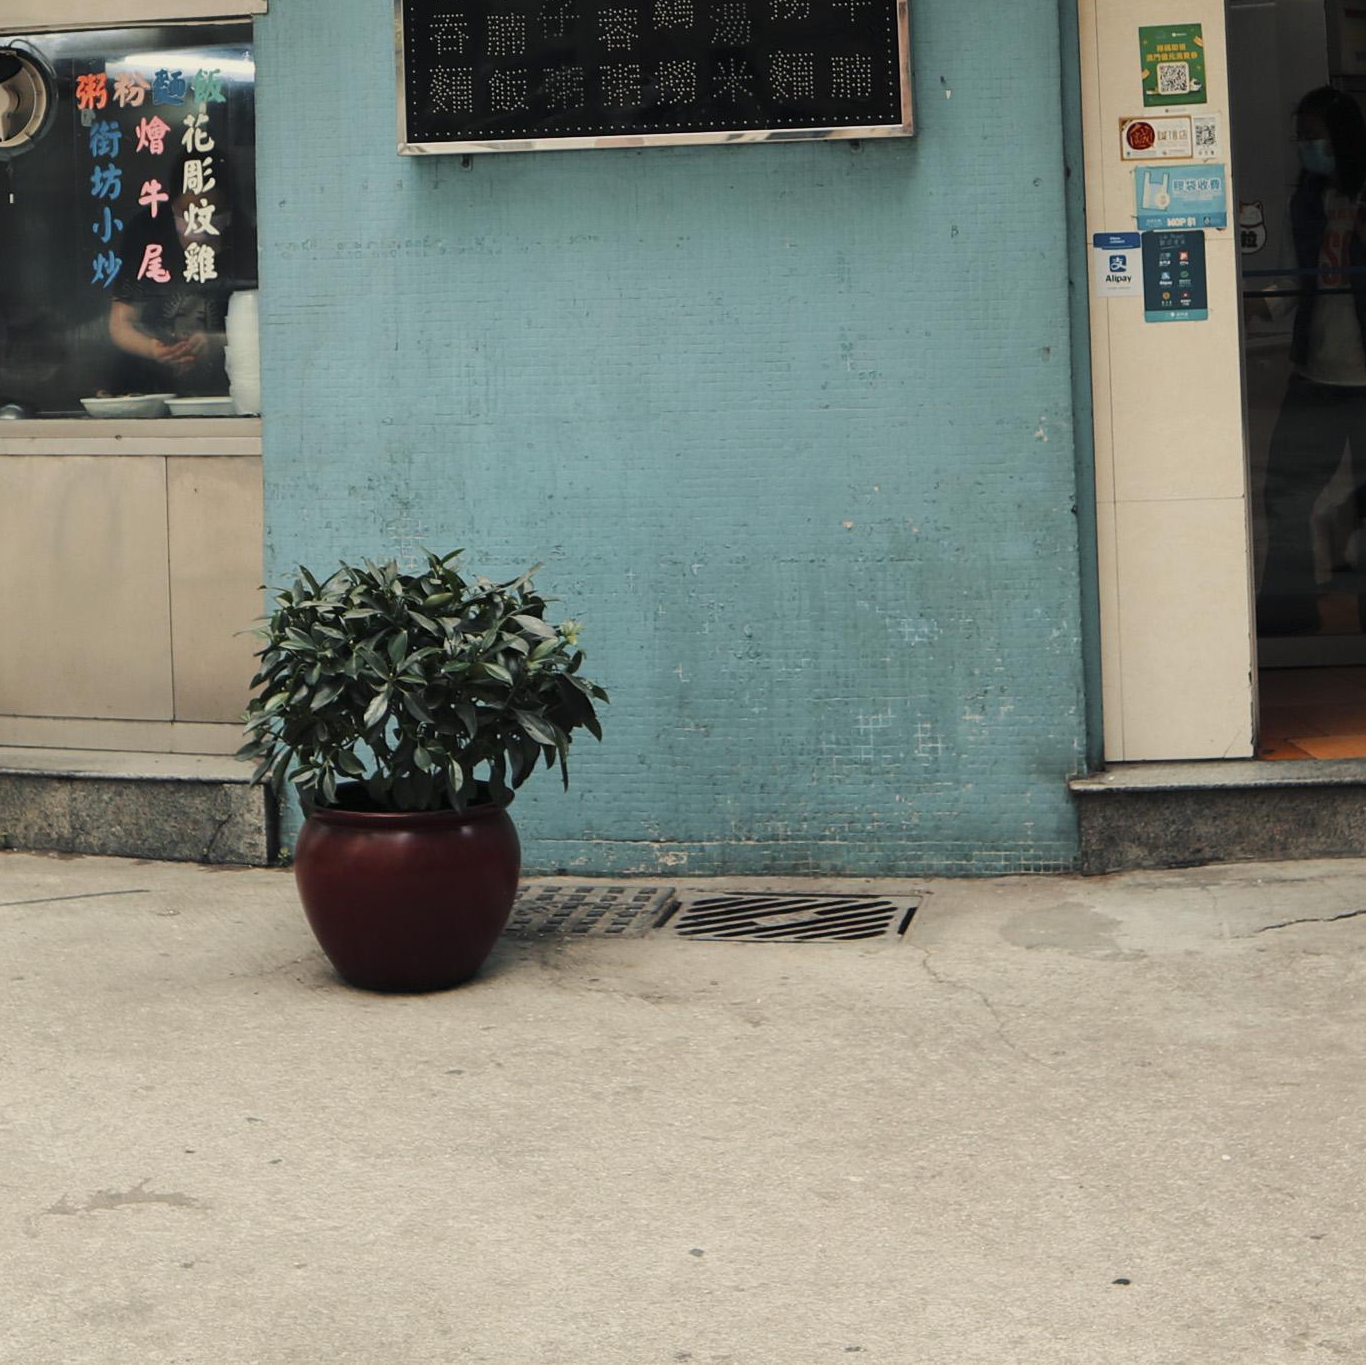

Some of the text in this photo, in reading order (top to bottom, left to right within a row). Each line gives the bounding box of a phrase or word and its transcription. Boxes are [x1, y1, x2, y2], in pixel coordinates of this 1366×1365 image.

[90, 120, 124, 288] 街坊小炒
[135, 115, 172, 283] 燴牛尾
[1105, 274, 1132, 284] Alipay
